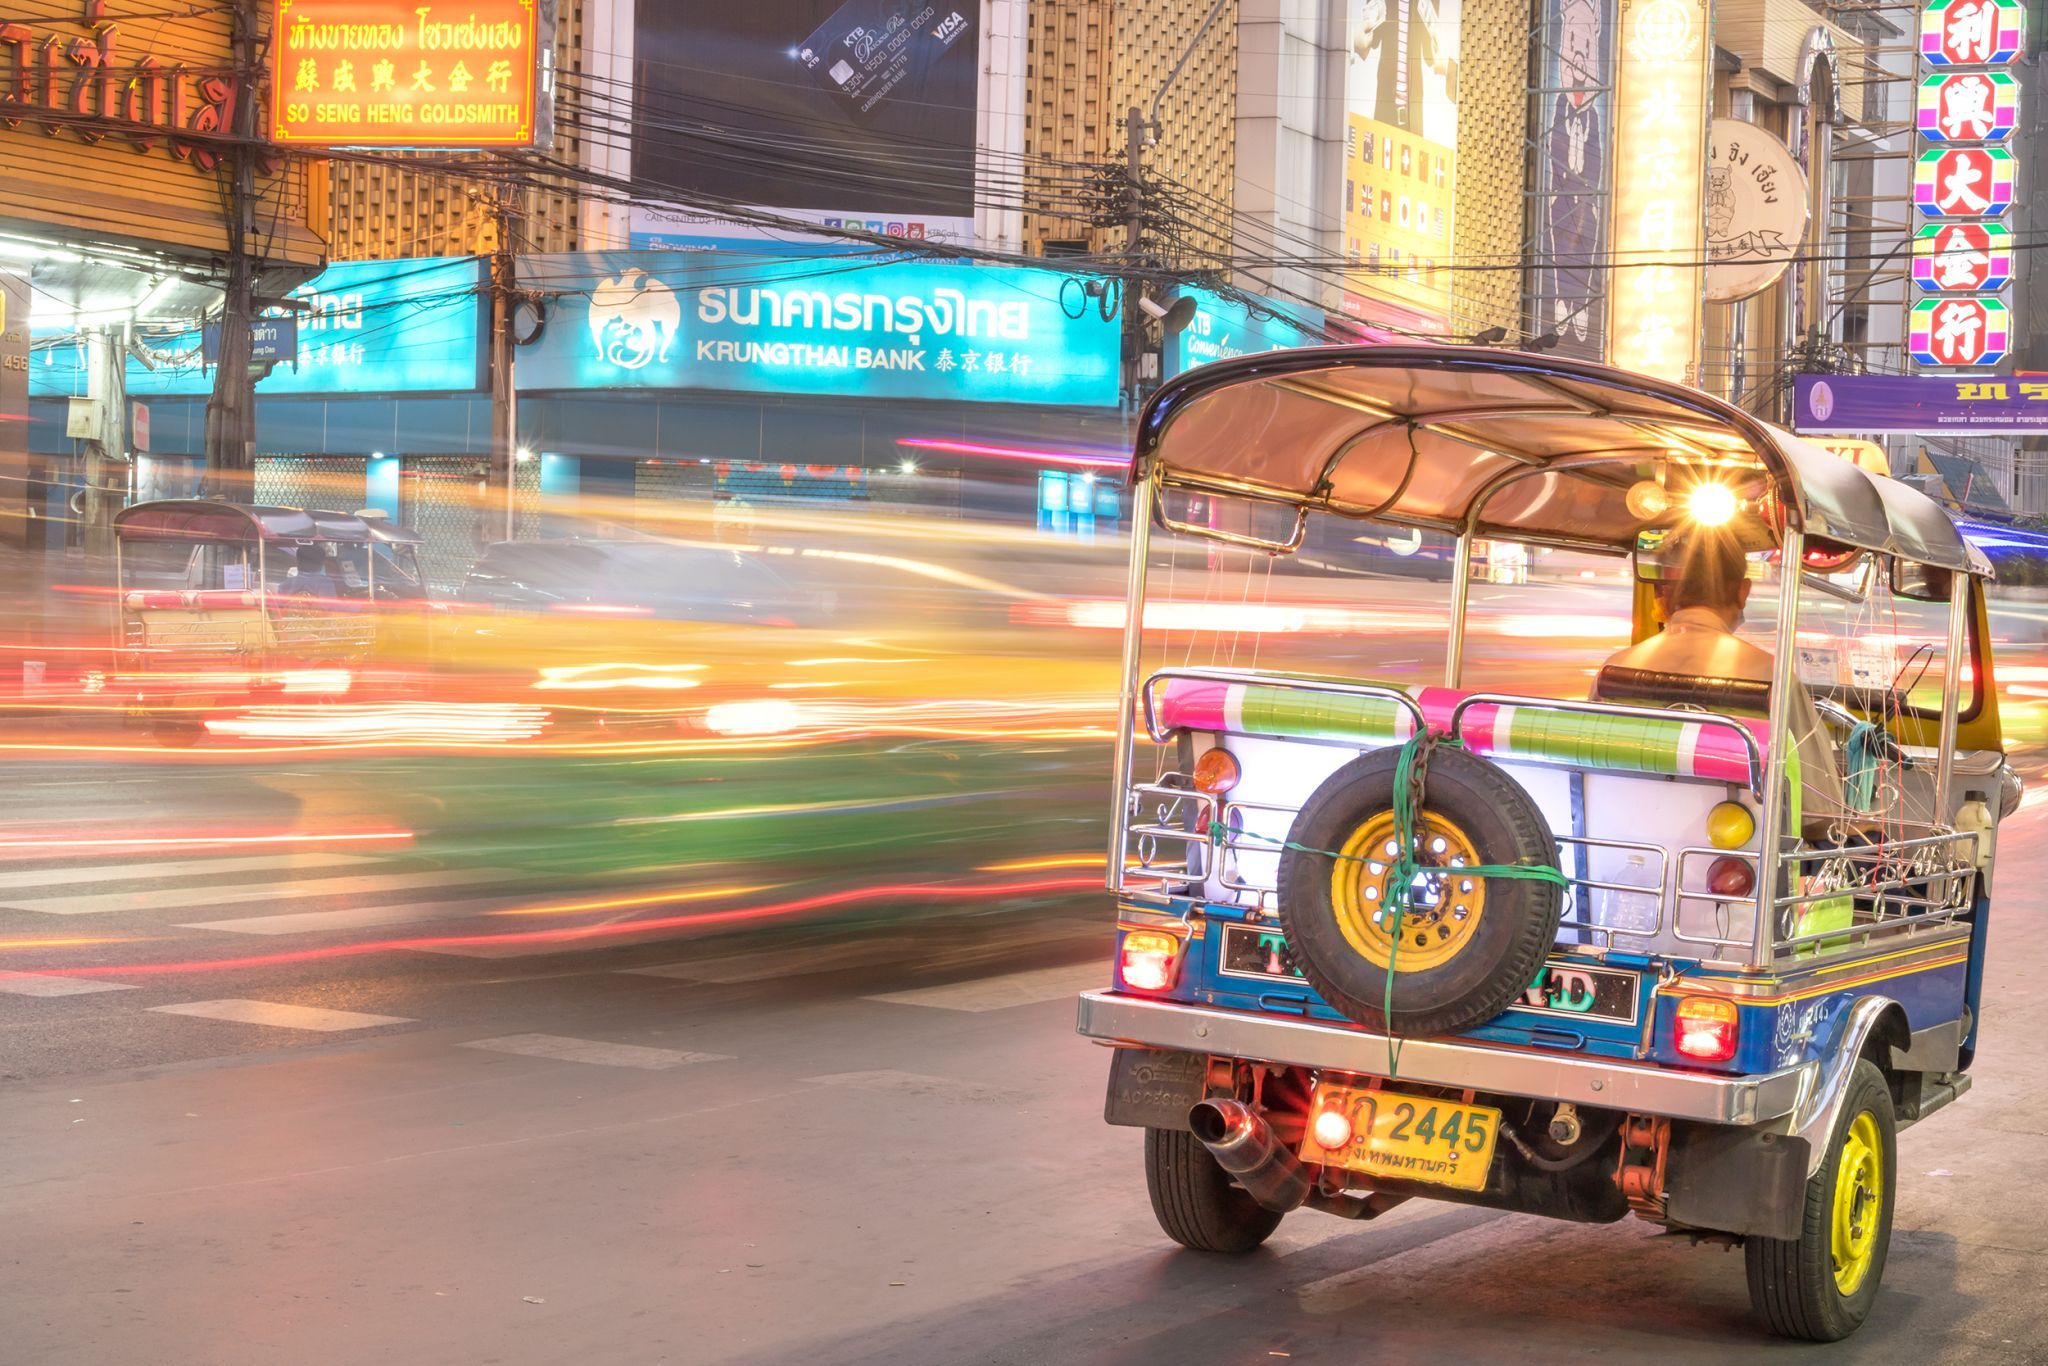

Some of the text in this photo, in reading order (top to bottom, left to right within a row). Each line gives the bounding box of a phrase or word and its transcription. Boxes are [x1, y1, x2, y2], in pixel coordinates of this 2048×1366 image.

[843, 26, 865, 48] KTB
[930, 11, 964, 41] VISA
[842, 72, 865, 93] 4304
[864, 51, 888, 72] 4500
[887, 28, 912, 51] 0000
[910, 6, 935, 30] 0000
[287, 104, 519, 124] SO SENG HENG GOLDSMITH
[697, 287, 1029, 346] ธนาคารกรุงไทย
[4, 354, 28, 370] 456
[696, 340, 926, 371] KRUNGTHAI BANK
[1389, 1101, 1489, 1153] 2445
